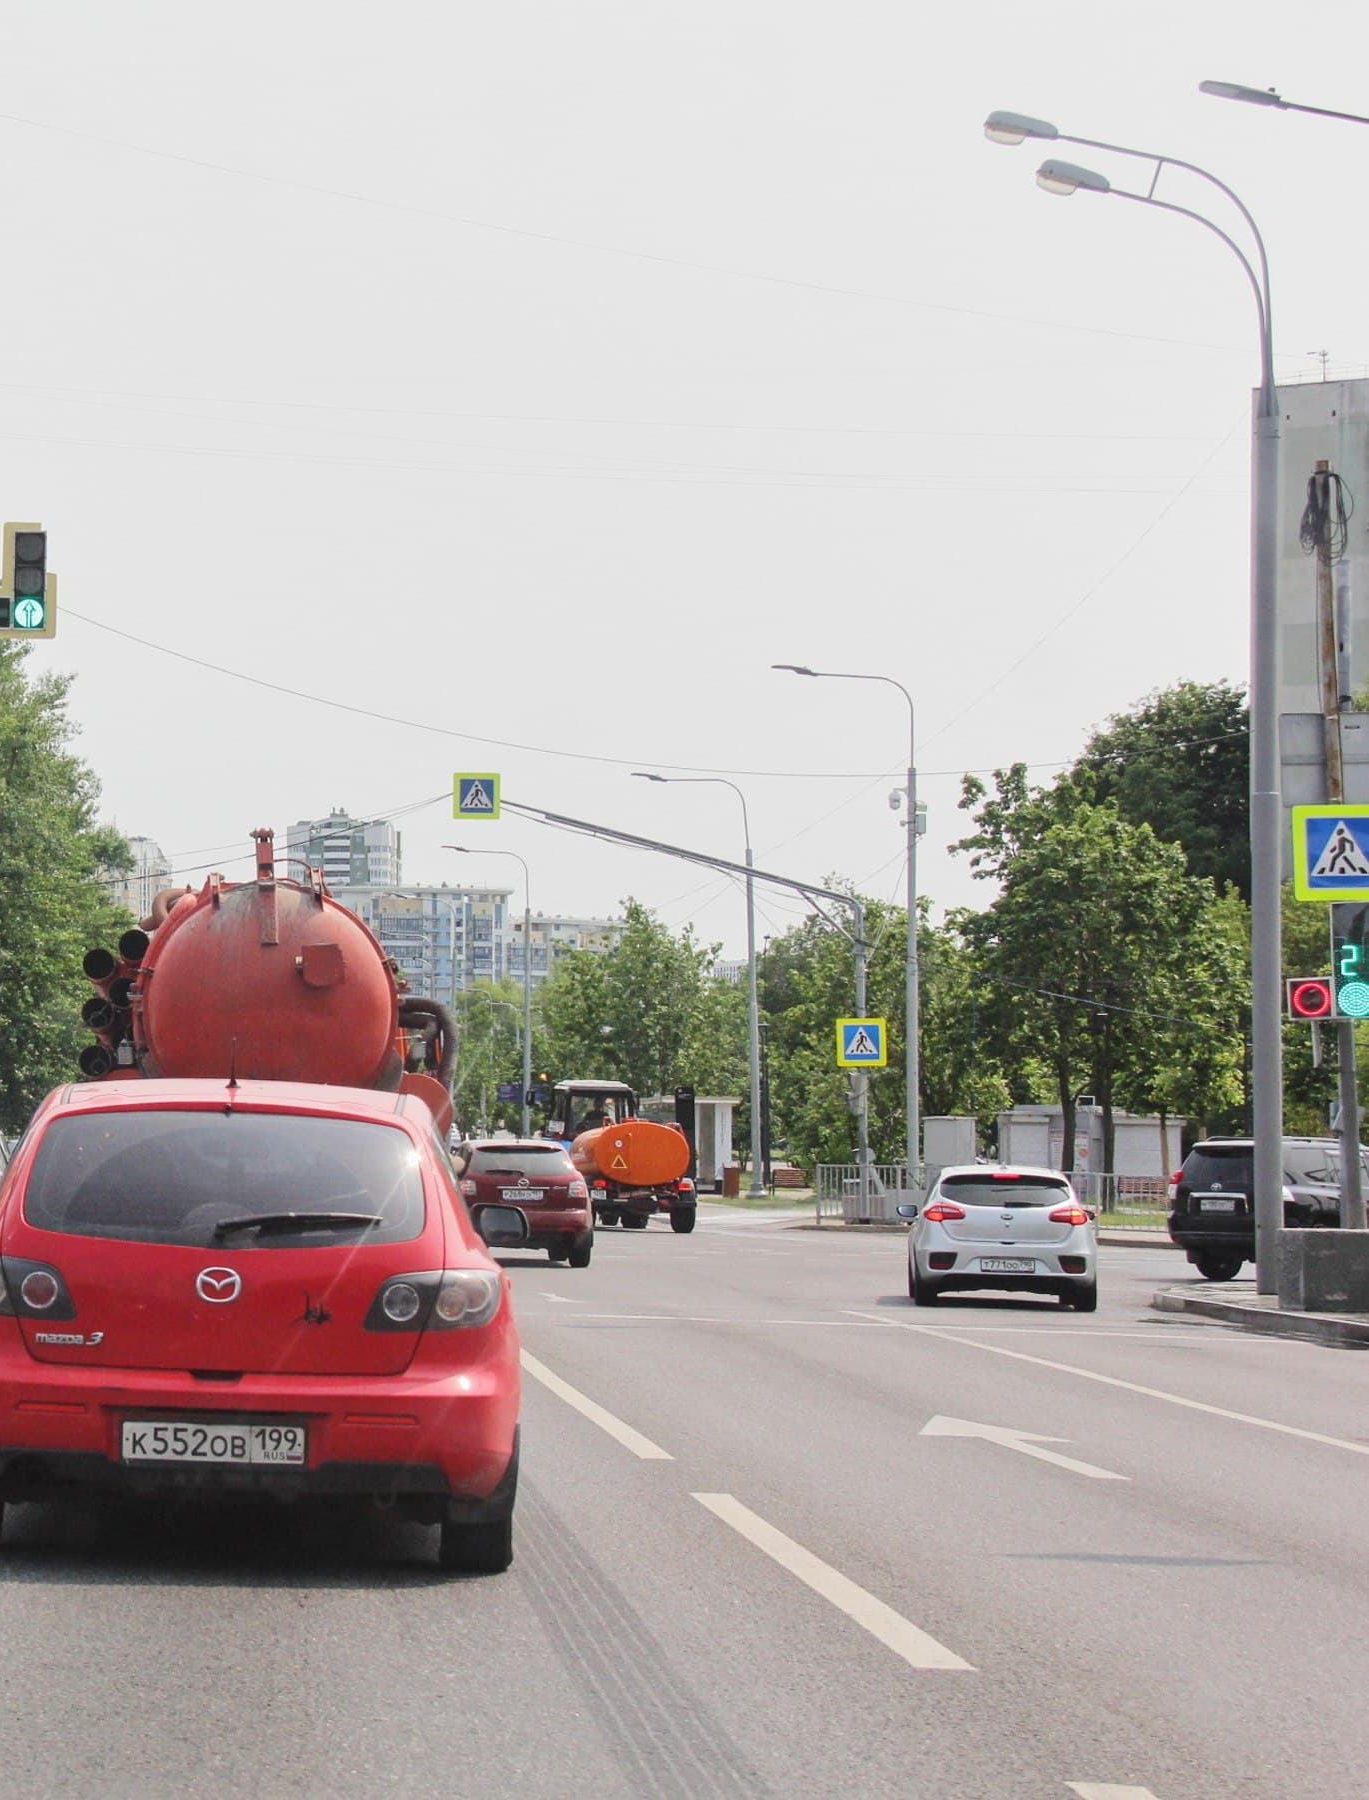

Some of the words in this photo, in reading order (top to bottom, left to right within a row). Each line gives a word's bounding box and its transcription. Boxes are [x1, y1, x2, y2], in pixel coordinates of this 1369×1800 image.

[85, 1331, 104, 1346] 3
[131, 1426, 247, 1459] К552ОВ
[254, 1428, 298, 1451] 199
[263, 1451, 286, 1461] RUS
